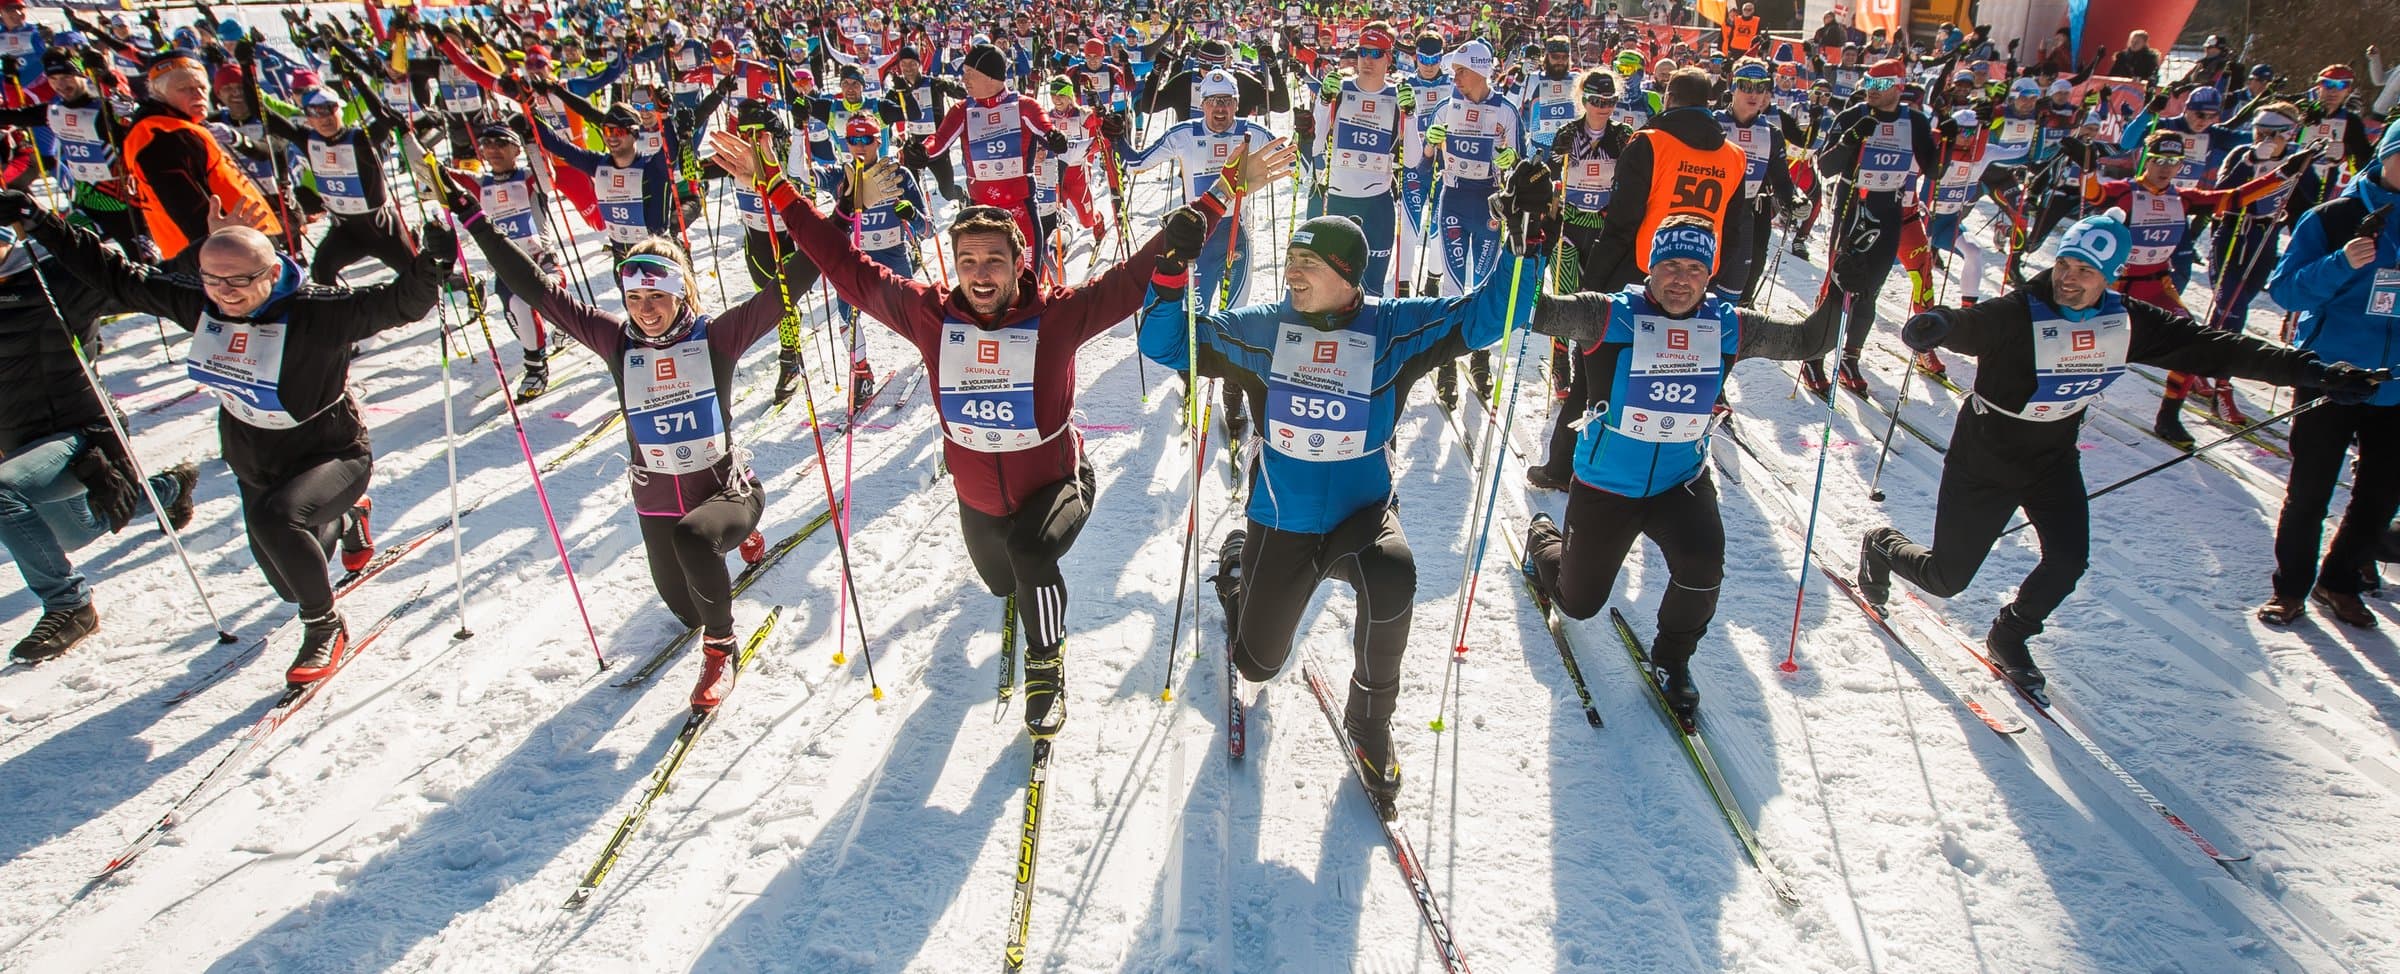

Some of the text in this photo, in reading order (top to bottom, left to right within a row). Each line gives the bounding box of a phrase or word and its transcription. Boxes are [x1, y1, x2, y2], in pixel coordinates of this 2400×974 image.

[1550, 106, 1565, 116] 60
[1352, 131, 1378, 146] 153
[65, 145, 90, 158] 126
[987, 140, 1007, 154] 59
[1454, 140, 1480, 154] 105
[1873, 153, 1900, 167] 107
[1677, 160, 1726, 178] Jizerská
[326, 179, 346, 192] 83
[1583, 193, 1599, 205] 81
[1669, 175, 1723, 213] 50
[1947, 189, 1963, 199] 86
[611, 207, 629, 219] 58
[860, 211, 887, 226] 577
[2060, 223, 2117, 262] 50
[2143, 229, 2171, 242] 147
[1655, 352, 1685, 361] SKUPINA
[964, 366, 995, 375] SKUPINA
[1298, 365, 1331, 374] SKUPINA
[1301, 373, 1344, 388] VOLKSWAGEN
[2055, 378, 2103, 395] 573
[1649, 381, 1697, 403] 382
[961, 399, 1014, 421] 486
[1290, 395, 1346, 421] 550
[653, 410, 698, 435] 571
[1008, 890, 1025, 944] FISCHER
